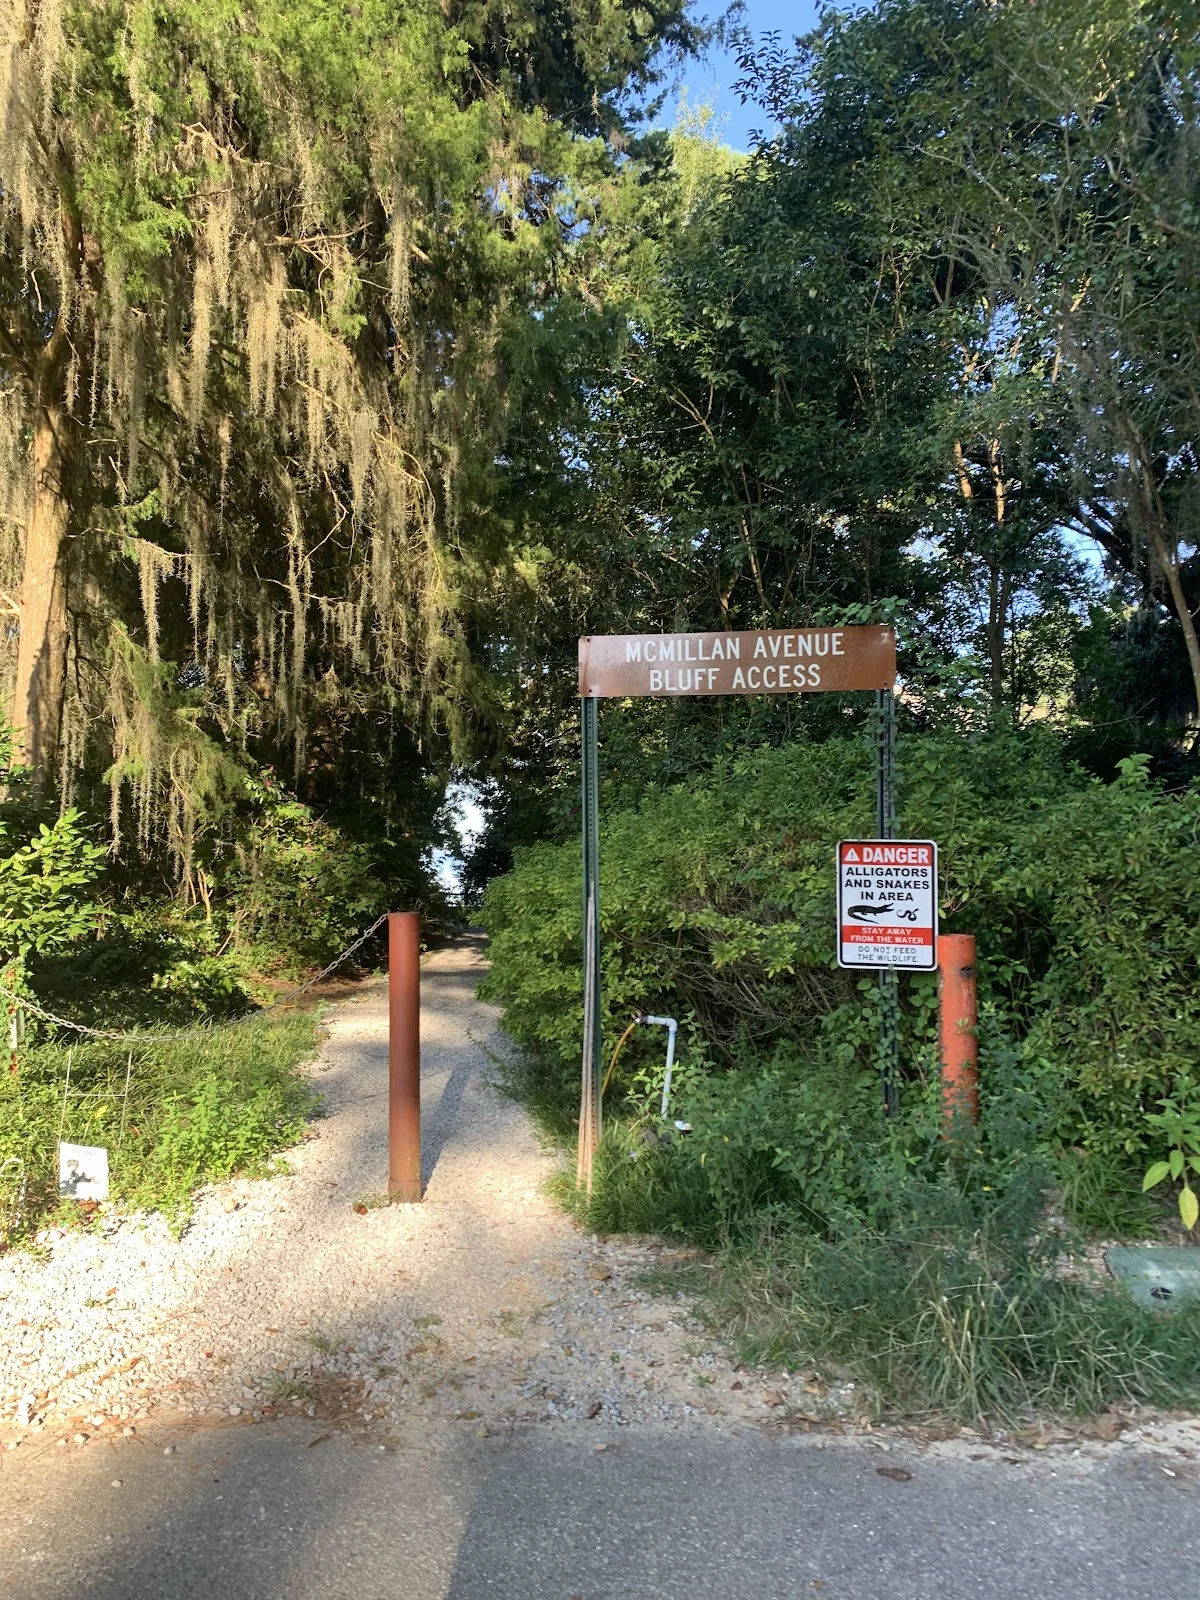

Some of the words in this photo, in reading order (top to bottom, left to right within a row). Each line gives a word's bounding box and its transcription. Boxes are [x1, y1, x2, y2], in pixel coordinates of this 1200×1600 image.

[626, 637, 740, 663] MCMILLAN
[753, 632, 845, 659] AVENUE
[649, 667, 720, 692] BLUFF
[732, 663, 821, 689] ACCESS
[862, 847, 929, 864] DANGER
[846, 867, 928, 877] ALLIGATORS
[844, 879, 872, 888] AND
[876, 880, 930, 890] SNAKES
[861, 891, 874, 901] IN
[878, 892, 914, 902] AREA
[862, 927, 885, 935] STAY
[886, 928, 912, 936] AWAY
[850, 935, 874, 943] FROM
[894, 936, 924, 945] WATER
[858, 945, 870, 953] DO
[873, 946, 891, 955] NOT
[893, 947, 917, 955] FEED
[858, 953, 874, 961] THE
[877, 954, 918, 963] WILDLIFE
